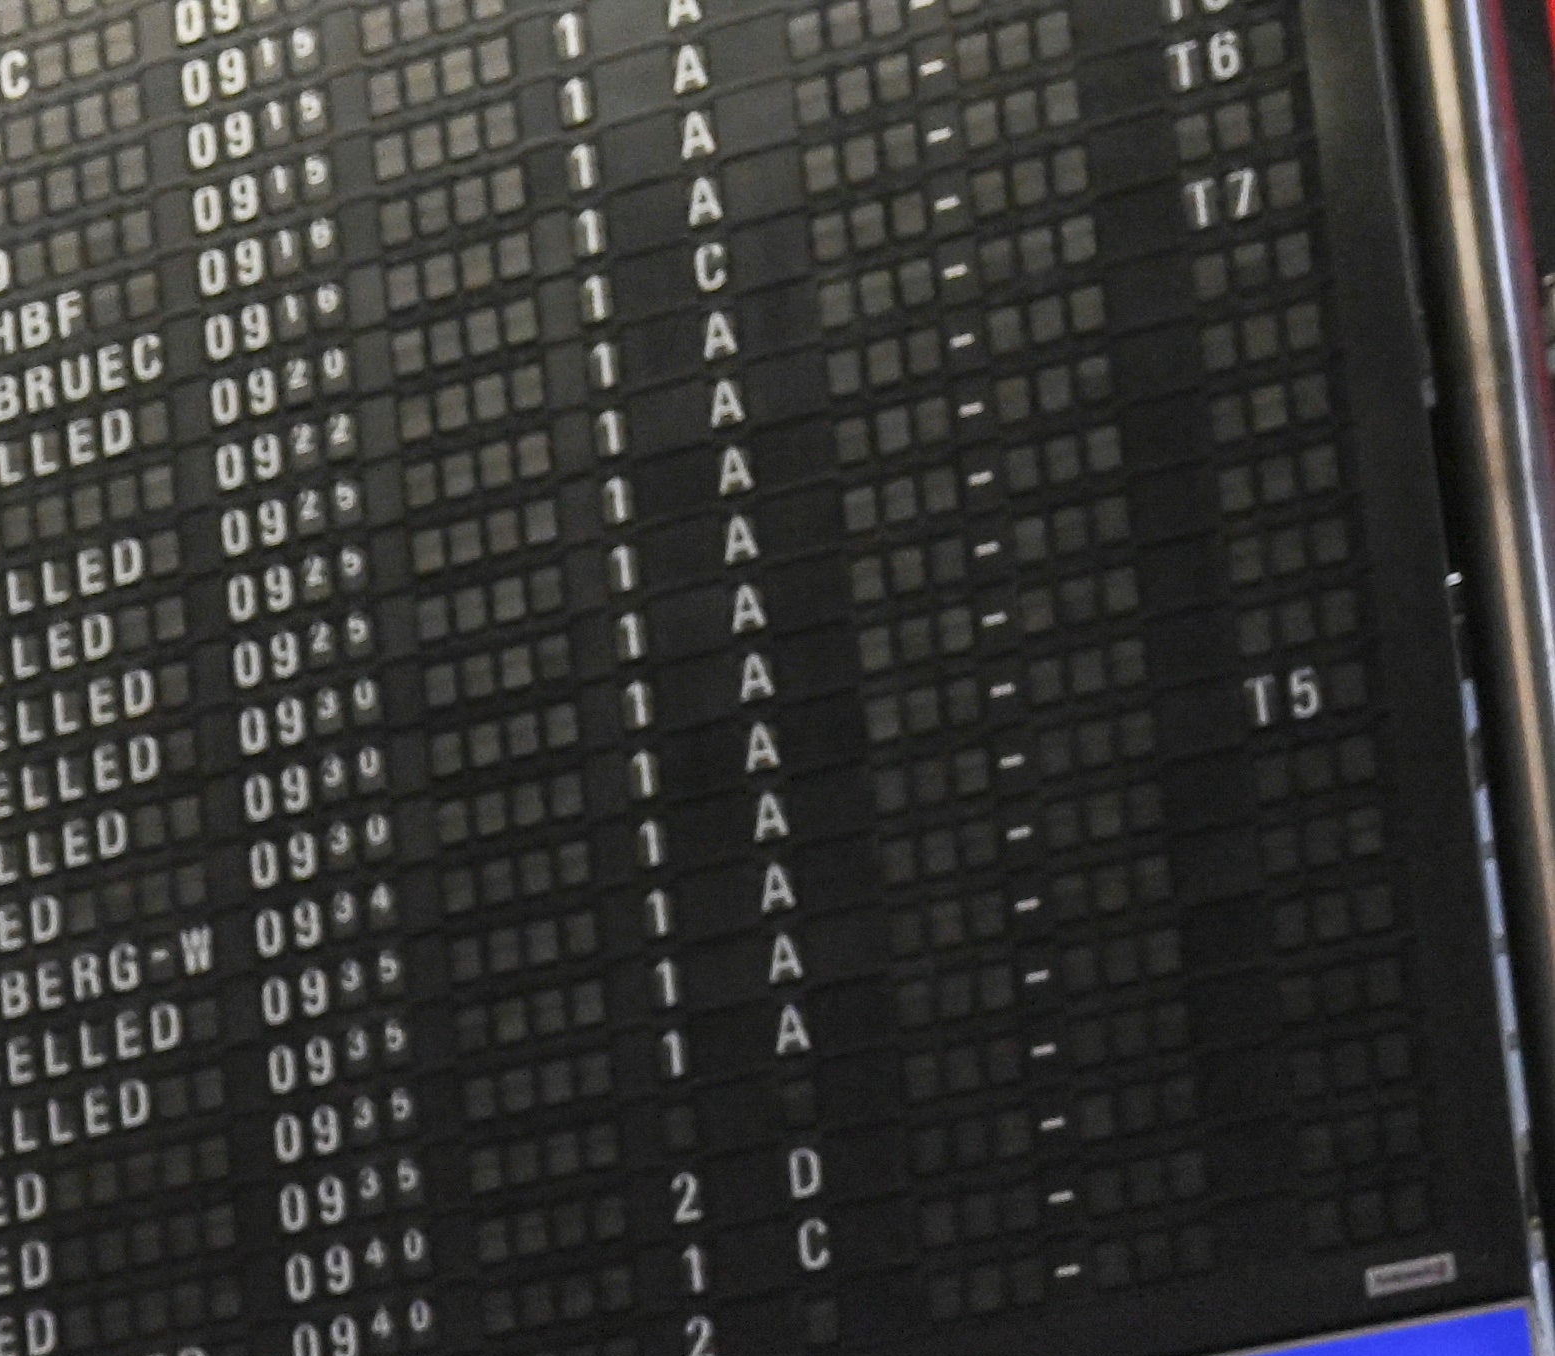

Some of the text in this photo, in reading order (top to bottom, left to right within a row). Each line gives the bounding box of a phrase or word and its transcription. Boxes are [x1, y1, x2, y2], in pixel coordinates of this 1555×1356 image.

[671, 43, 708, 96] A
[693, 241, 730, 294] C
[730, 579, 768, 633] A
[791, 1141, 830, 1196] D
[799, 1213, 839, 1268] C
